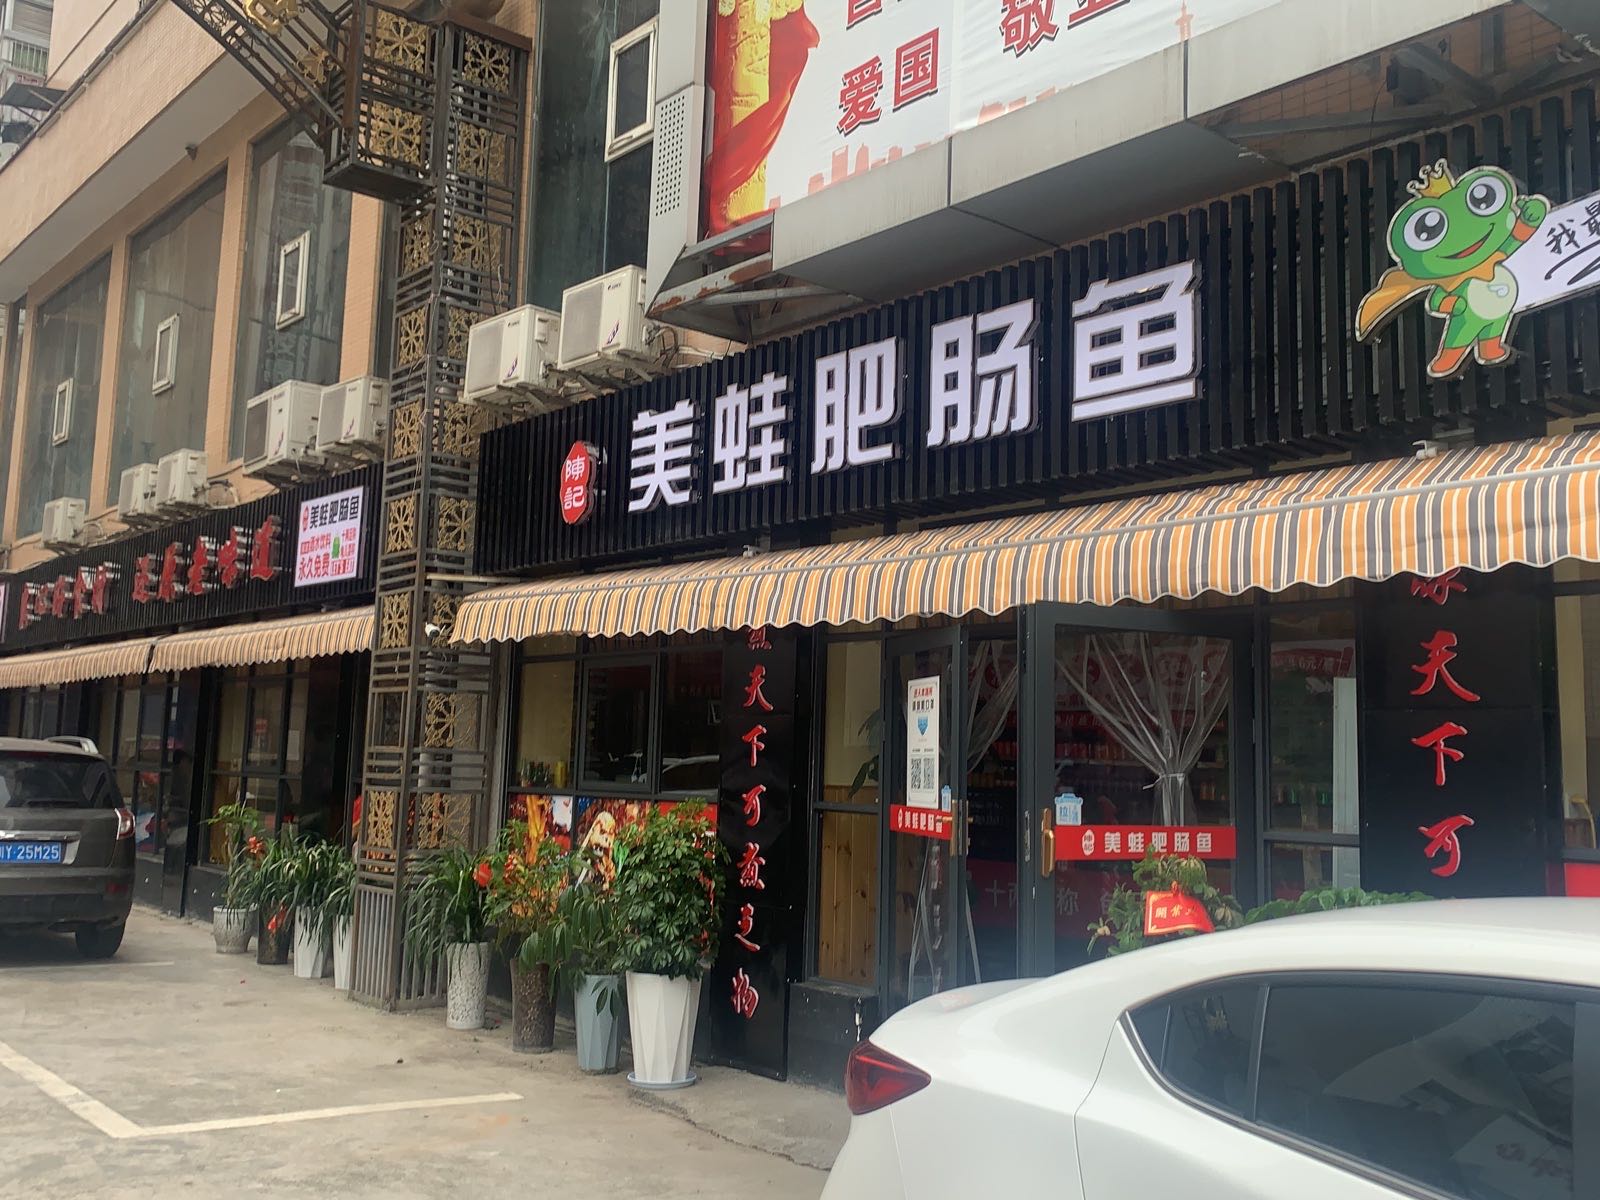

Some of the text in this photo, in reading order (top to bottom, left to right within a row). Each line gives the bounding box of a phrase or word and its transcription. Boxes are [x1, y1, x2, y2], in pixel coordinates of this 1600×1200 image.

[837, 28, 939, 135] 爱国
[627, 259, 1200, 513] 美蛙肥肠鱼
[563, 454, 586, 510] 陳記
[1104, 831, 1212, 853] 美蛙肥肠鱼
